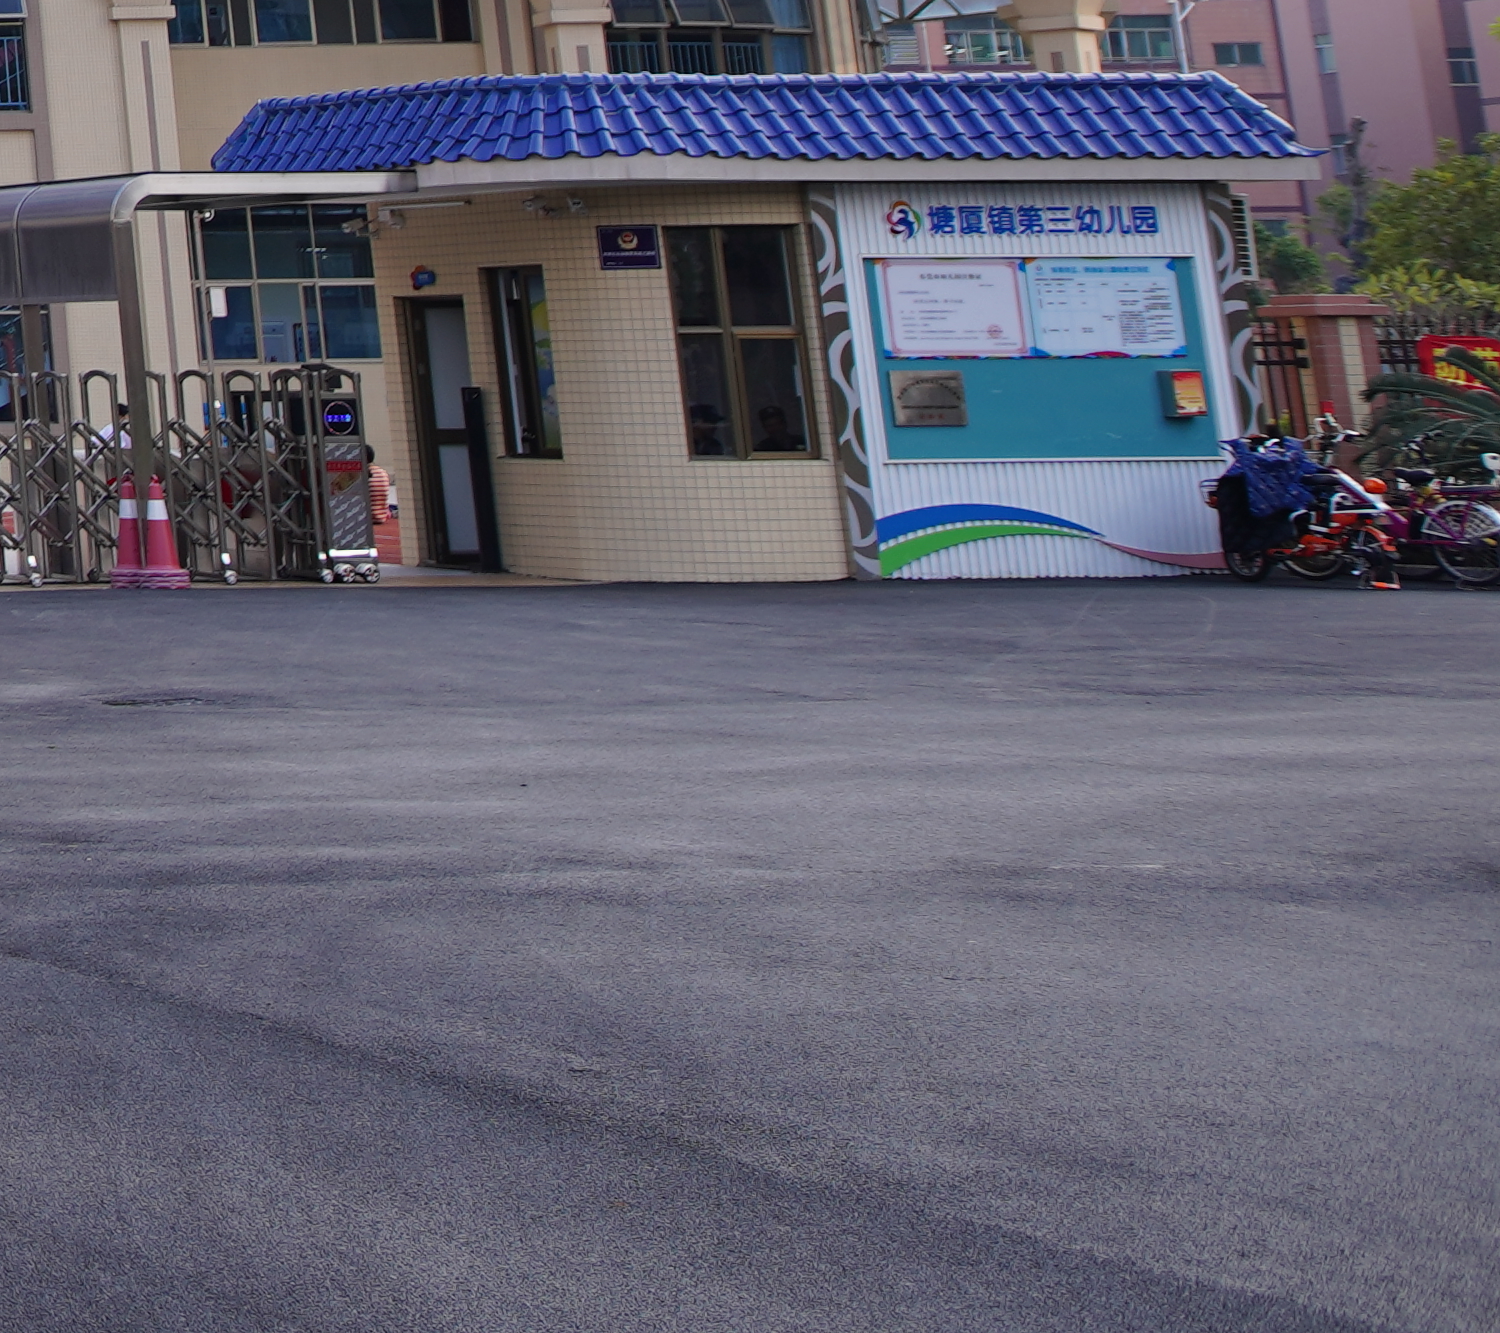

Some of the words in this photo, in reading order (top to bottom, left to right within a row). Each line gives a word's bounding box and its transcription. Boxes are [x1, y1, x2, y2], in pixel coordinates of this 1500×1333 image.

[927, 205, 1160, 236] 塘厦镇第三幼儿园
